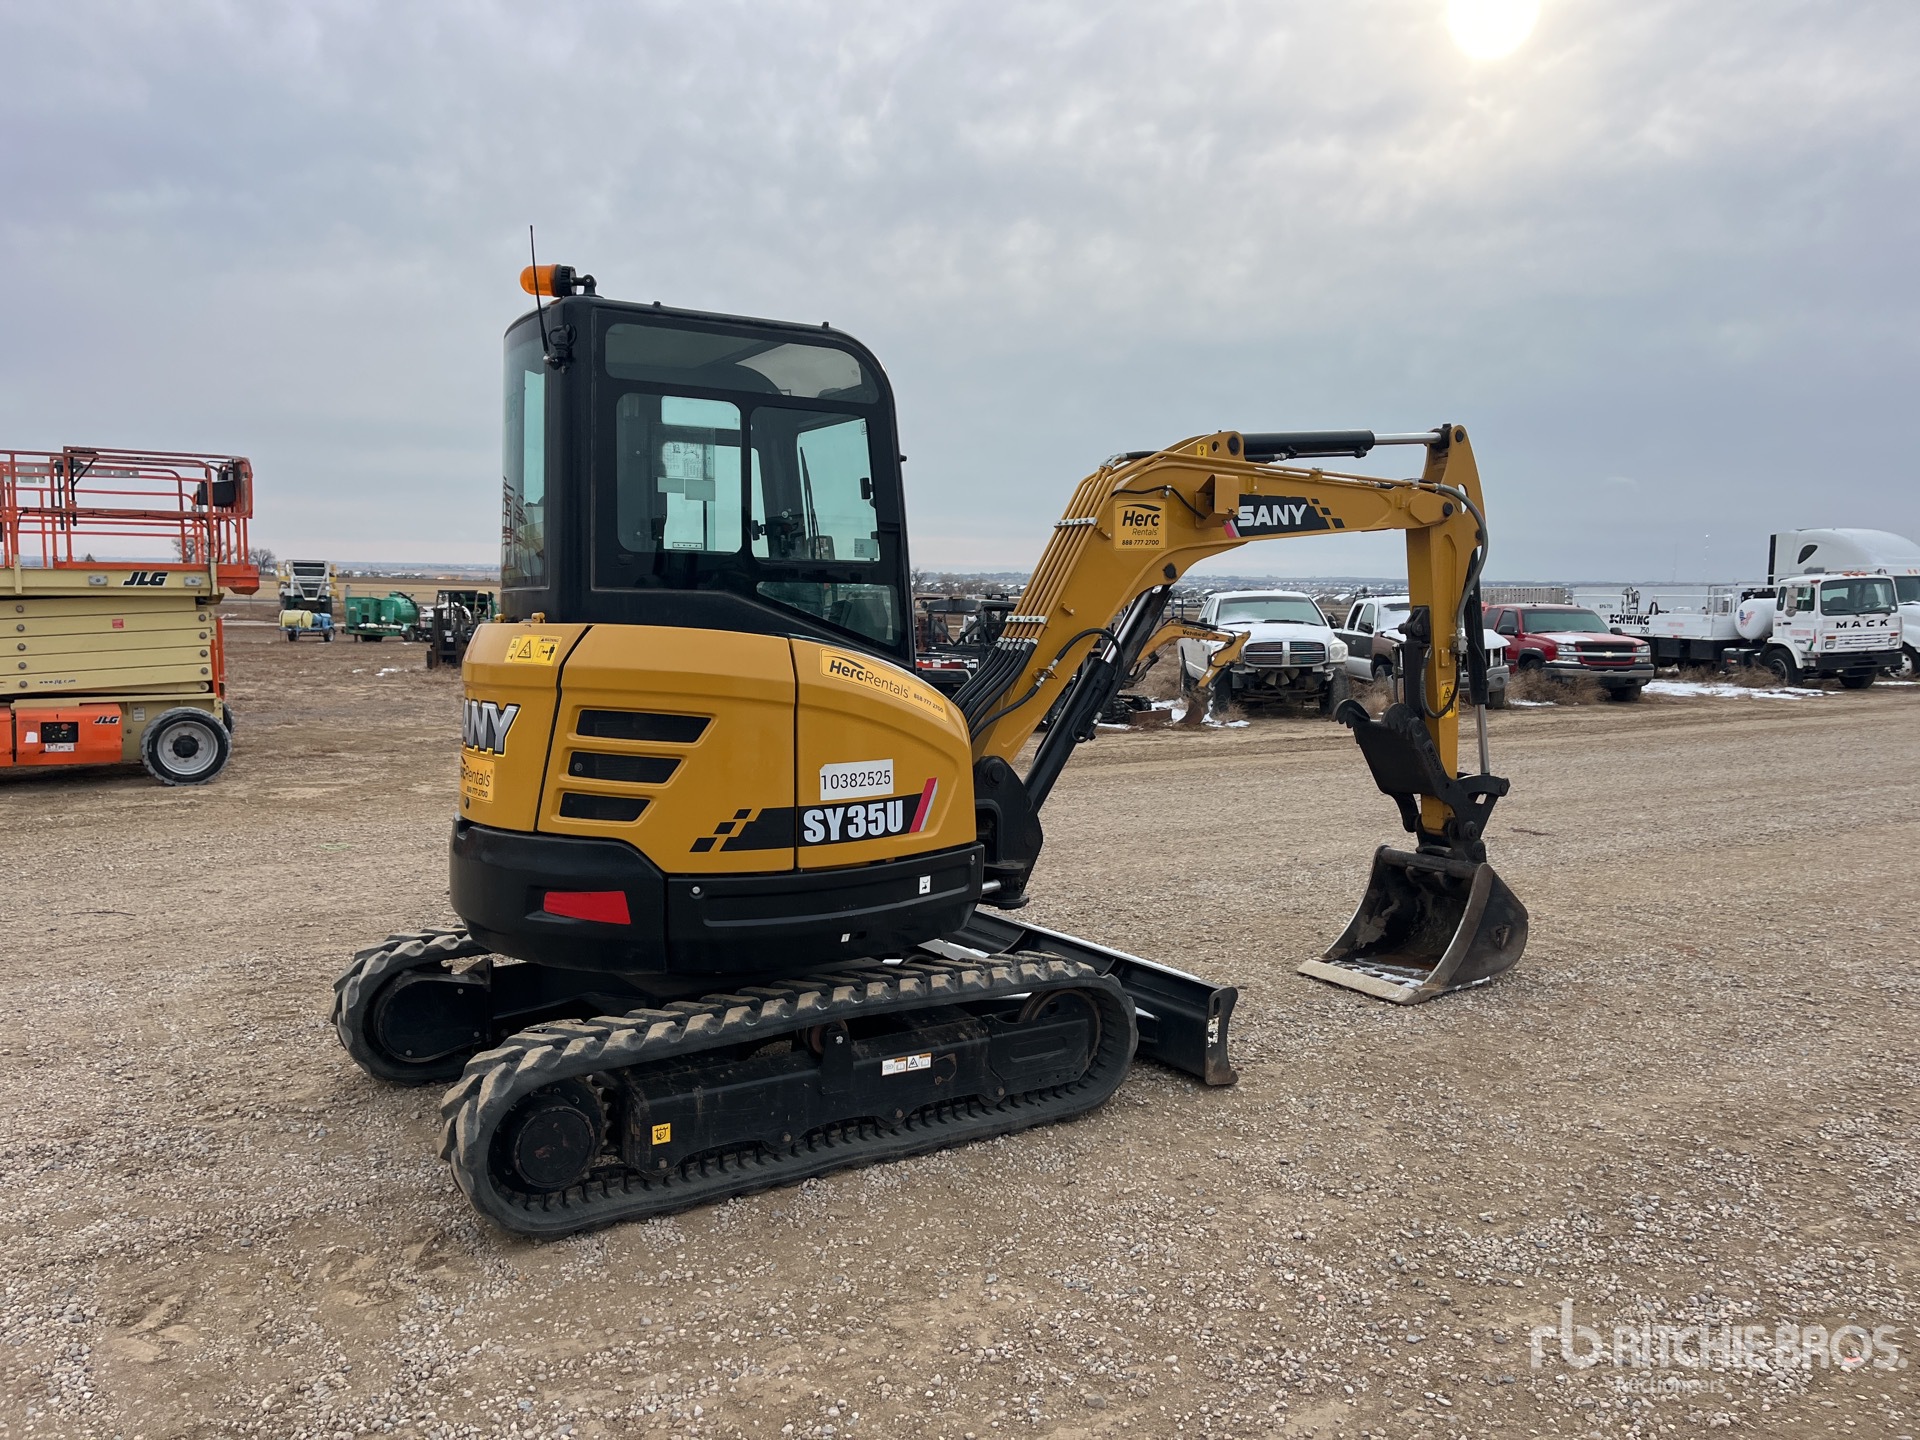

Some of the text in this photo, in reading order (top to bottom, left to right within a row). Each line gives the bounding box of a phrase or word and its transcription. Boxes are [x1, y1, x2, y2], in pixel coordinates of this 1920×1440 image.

[1122, 510, 1160, 526] Herc
[1238, 504, 1307, 527] SANY
[1132, 528, 1158, 536] Rentals
[123, 571, 168, 586] JLG
[1609, 614, 1650, 626] SCHWING
[1836, 619, 1889, 629] MACK
[1640, 626, 1650, 634] 750
[94, 716, 119, 725] JLG
[463, 698, 520, 755] ANY
[821, 769, 891, 790] 10382525
[803, 799, 903, 843] SY35U
